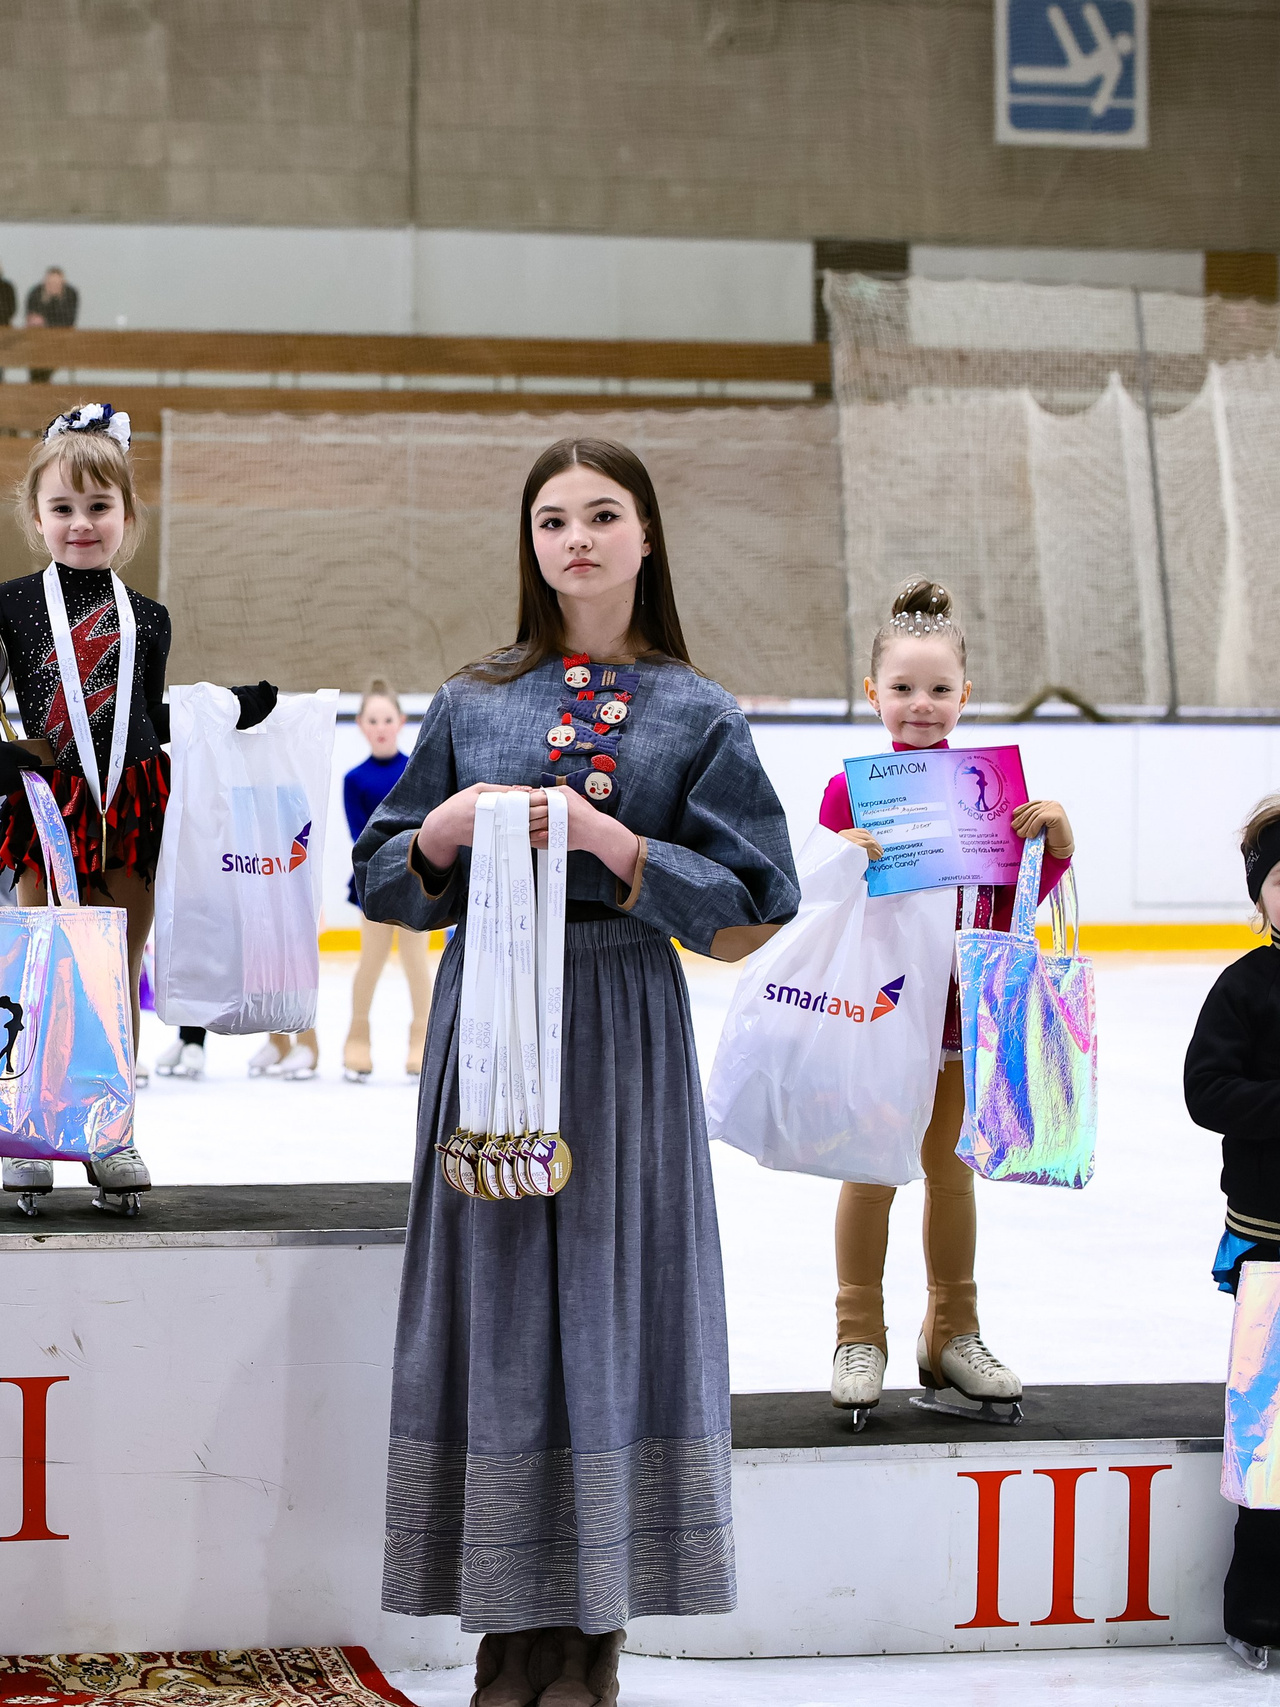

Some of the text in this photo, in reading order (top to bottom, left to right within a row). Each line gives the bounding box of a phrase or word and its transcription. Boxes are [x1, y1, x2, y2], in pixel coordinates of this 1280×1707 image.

[858, 796, 907, 808] Награждается
[958, 797, 1010, 822] КУБОК CANDY
[862, 819, 895, 828] занявшая
[917, 848, 944, 856] катанию
[764, 983, 865, 1023] smartava
[552, 1162, 560, 1179] 1
[0, 1375, 70, 1542] I
[954, 1464, 1172, 1630] III
